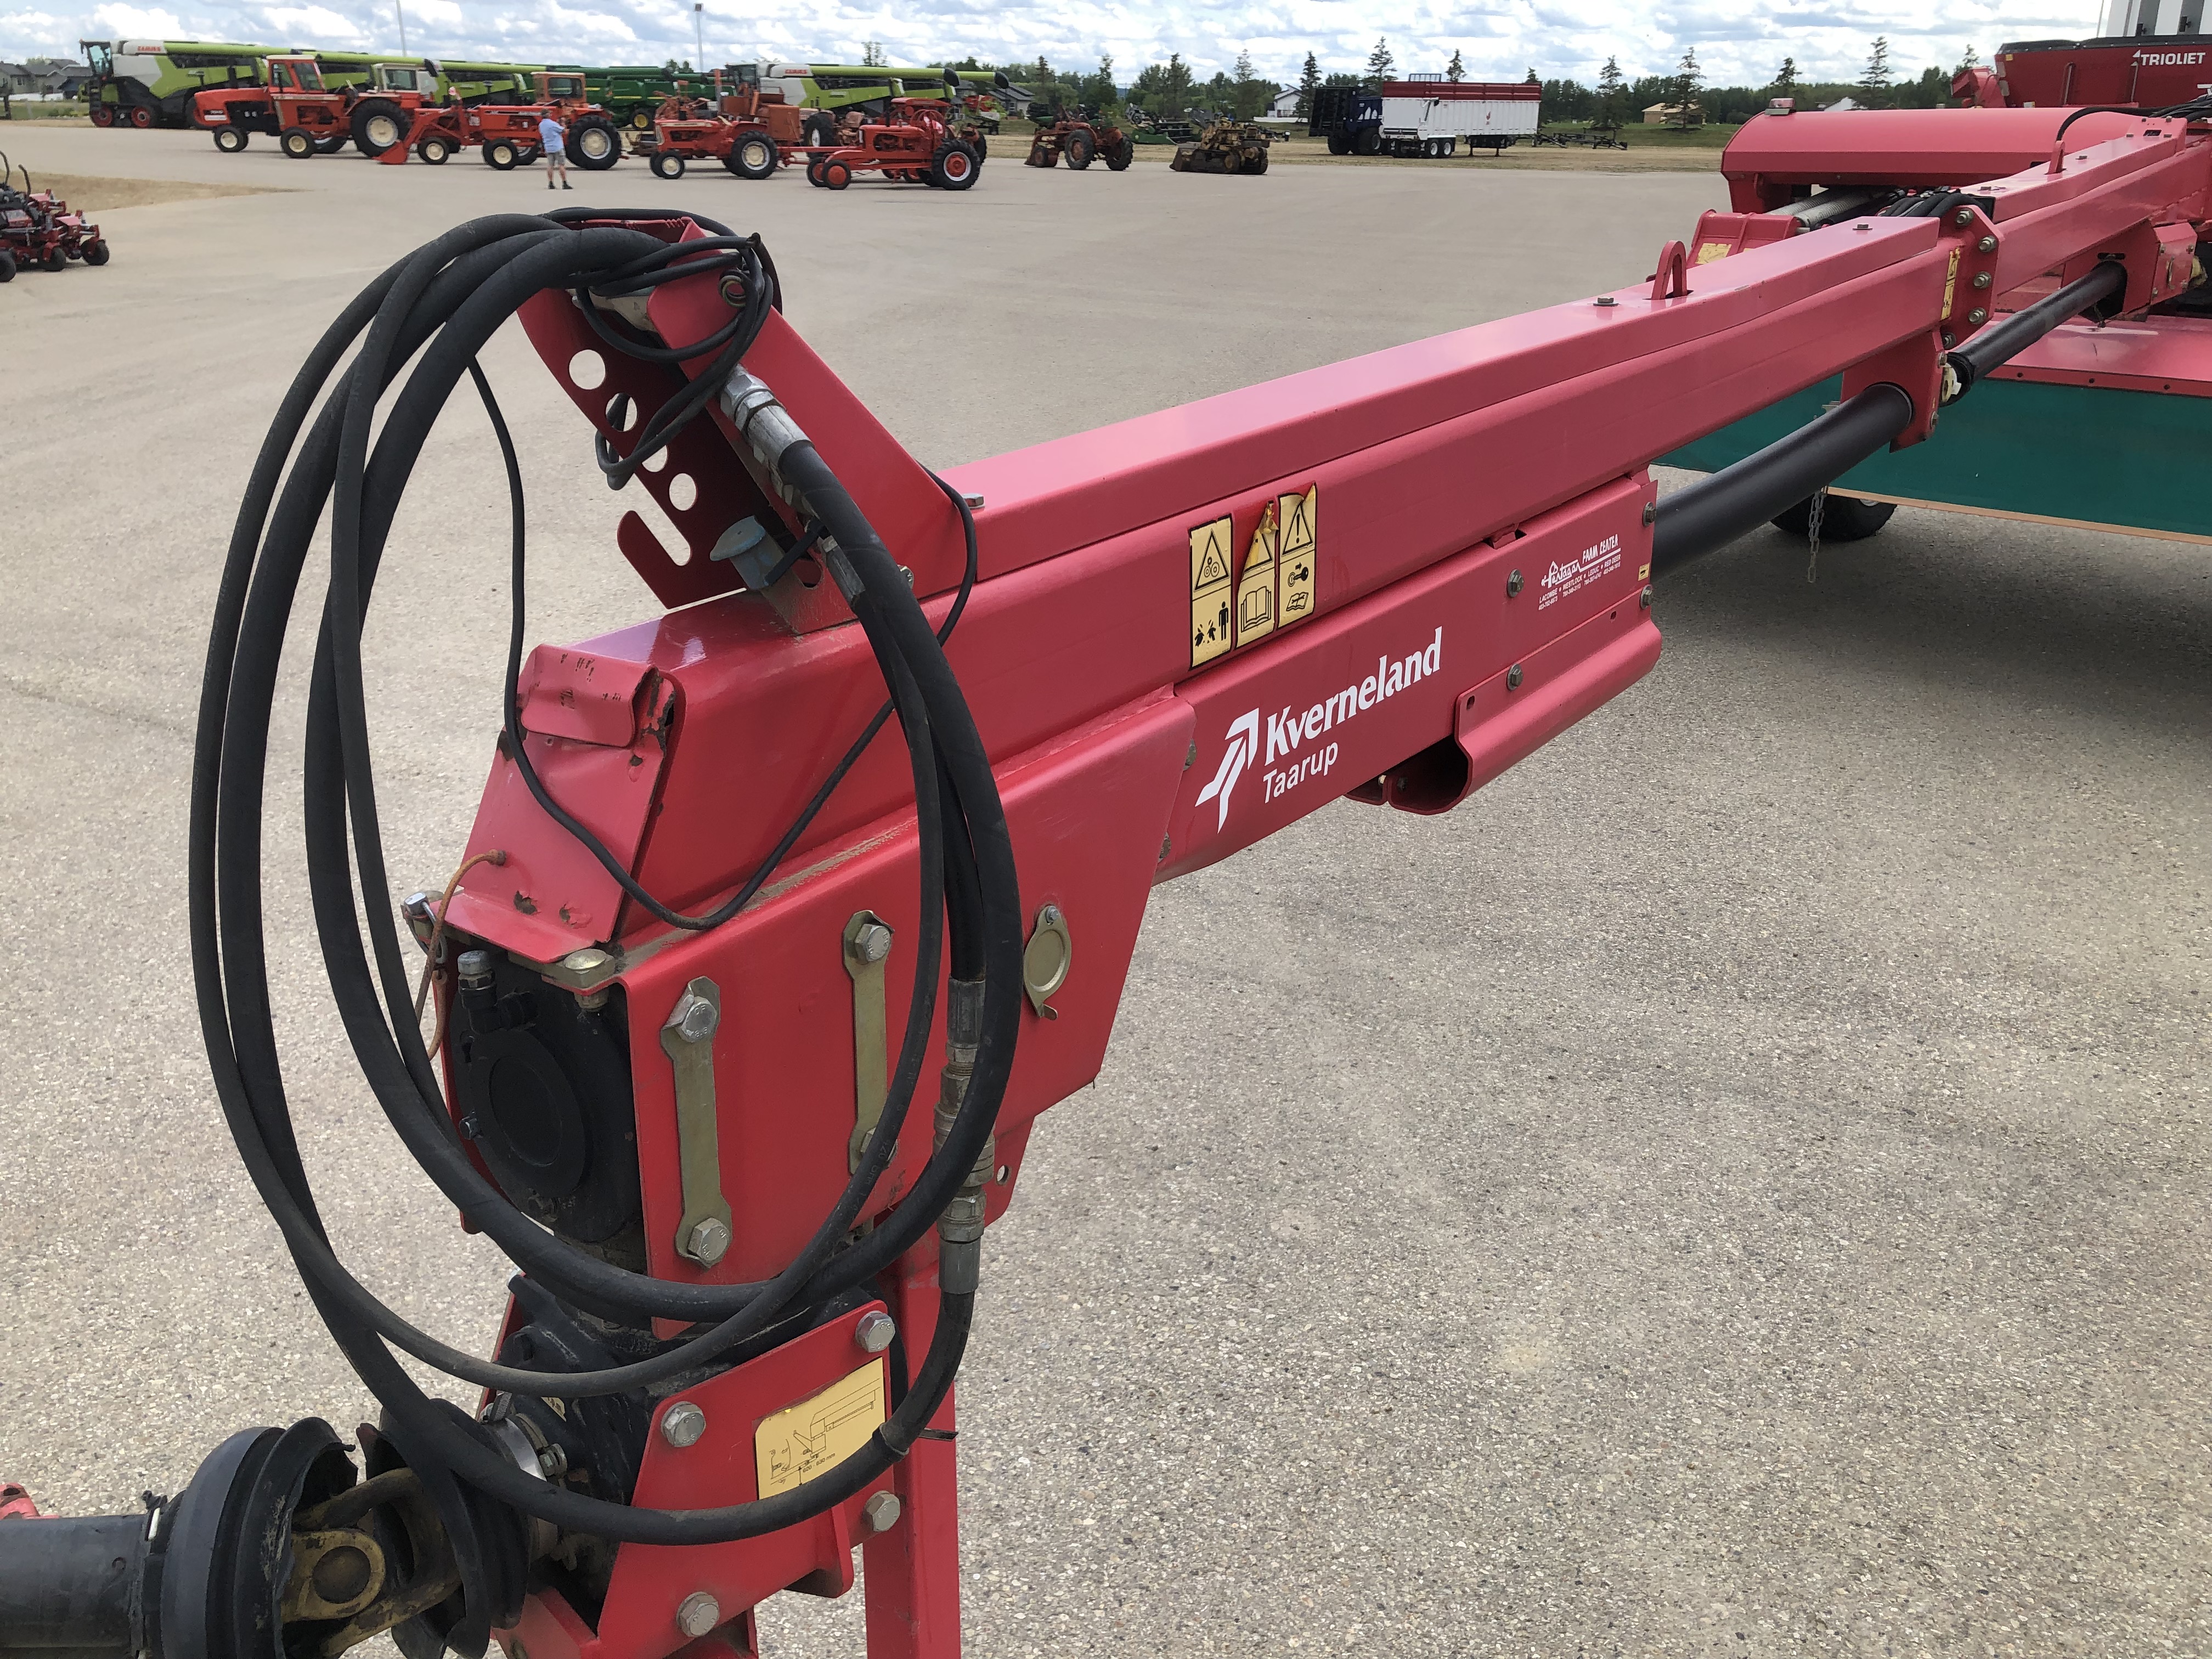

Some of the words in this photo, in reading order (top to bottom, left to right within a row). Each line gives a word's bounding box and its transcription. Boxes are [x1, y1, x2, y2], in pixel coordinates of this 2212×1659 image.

[2141, 52, 2206, 65] TRIOLIET
[1539, 588, 1558, 603] LACOMBE
[1562, 574, 1583, 590] WESTLOCK
[1588, 566, 1600, 577] LEDUC
[1265, 626, 1442, 766] Kverneland
[1263, 742, 1338, 803] Taarup
